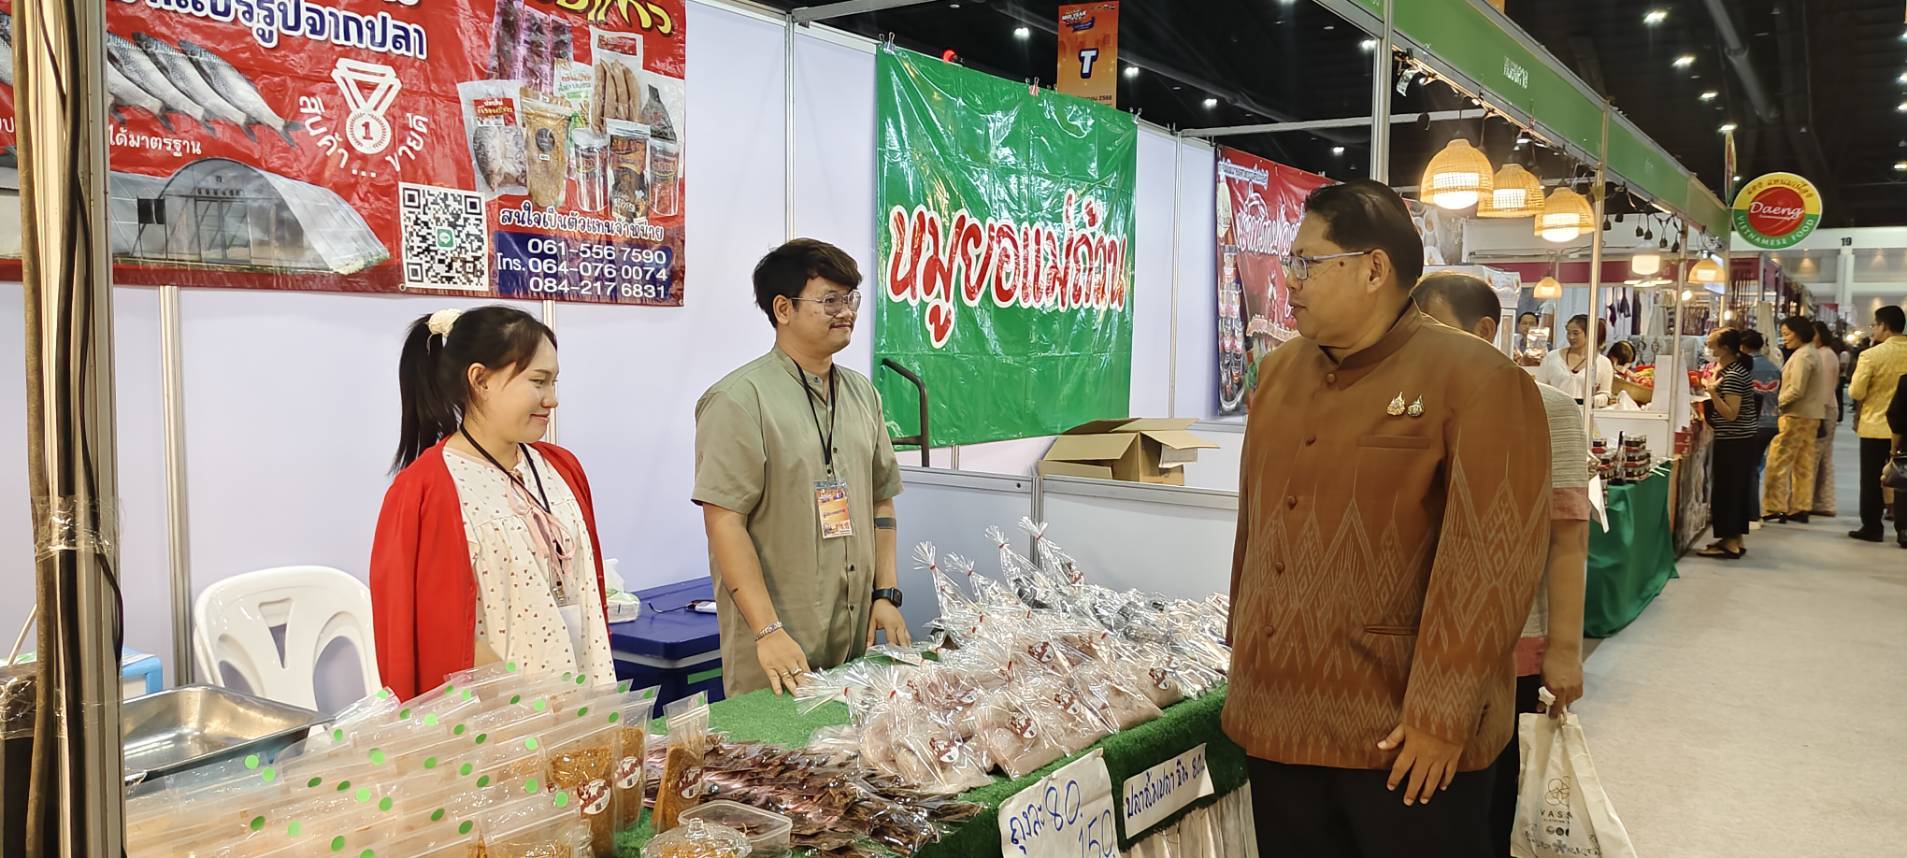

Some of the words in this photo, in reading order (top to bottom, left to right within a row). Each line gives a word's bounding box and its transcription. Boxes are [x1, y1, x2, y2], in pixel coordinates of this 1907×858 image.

[1079, 48, 1098, 78] T
[108, 124, 202, 157] ได้มาตรฐาน
[361, 121, 374, 141] 1
[499, 199, 665, 242] สนใจเป็นตัวแทนจำหน่าย
[1750, 201, 1804, 219] Daeng
[1737, 215, 1787, 245] VIETNAMESE
[1791, 219, 1814, 240] FOOD
[1841, 236, 1852, 246] 19
[527, 238, 616, 261] 061-556
[621, 248, 667, 265] 7590
[497, 252, 526, 272] โทร.
[528, 257, 617, 279] 064-076
[621, 266, 668, 282] 0074
[529, 277, 617, 296] 084-217
[621, 282, 666, 299] 6831
